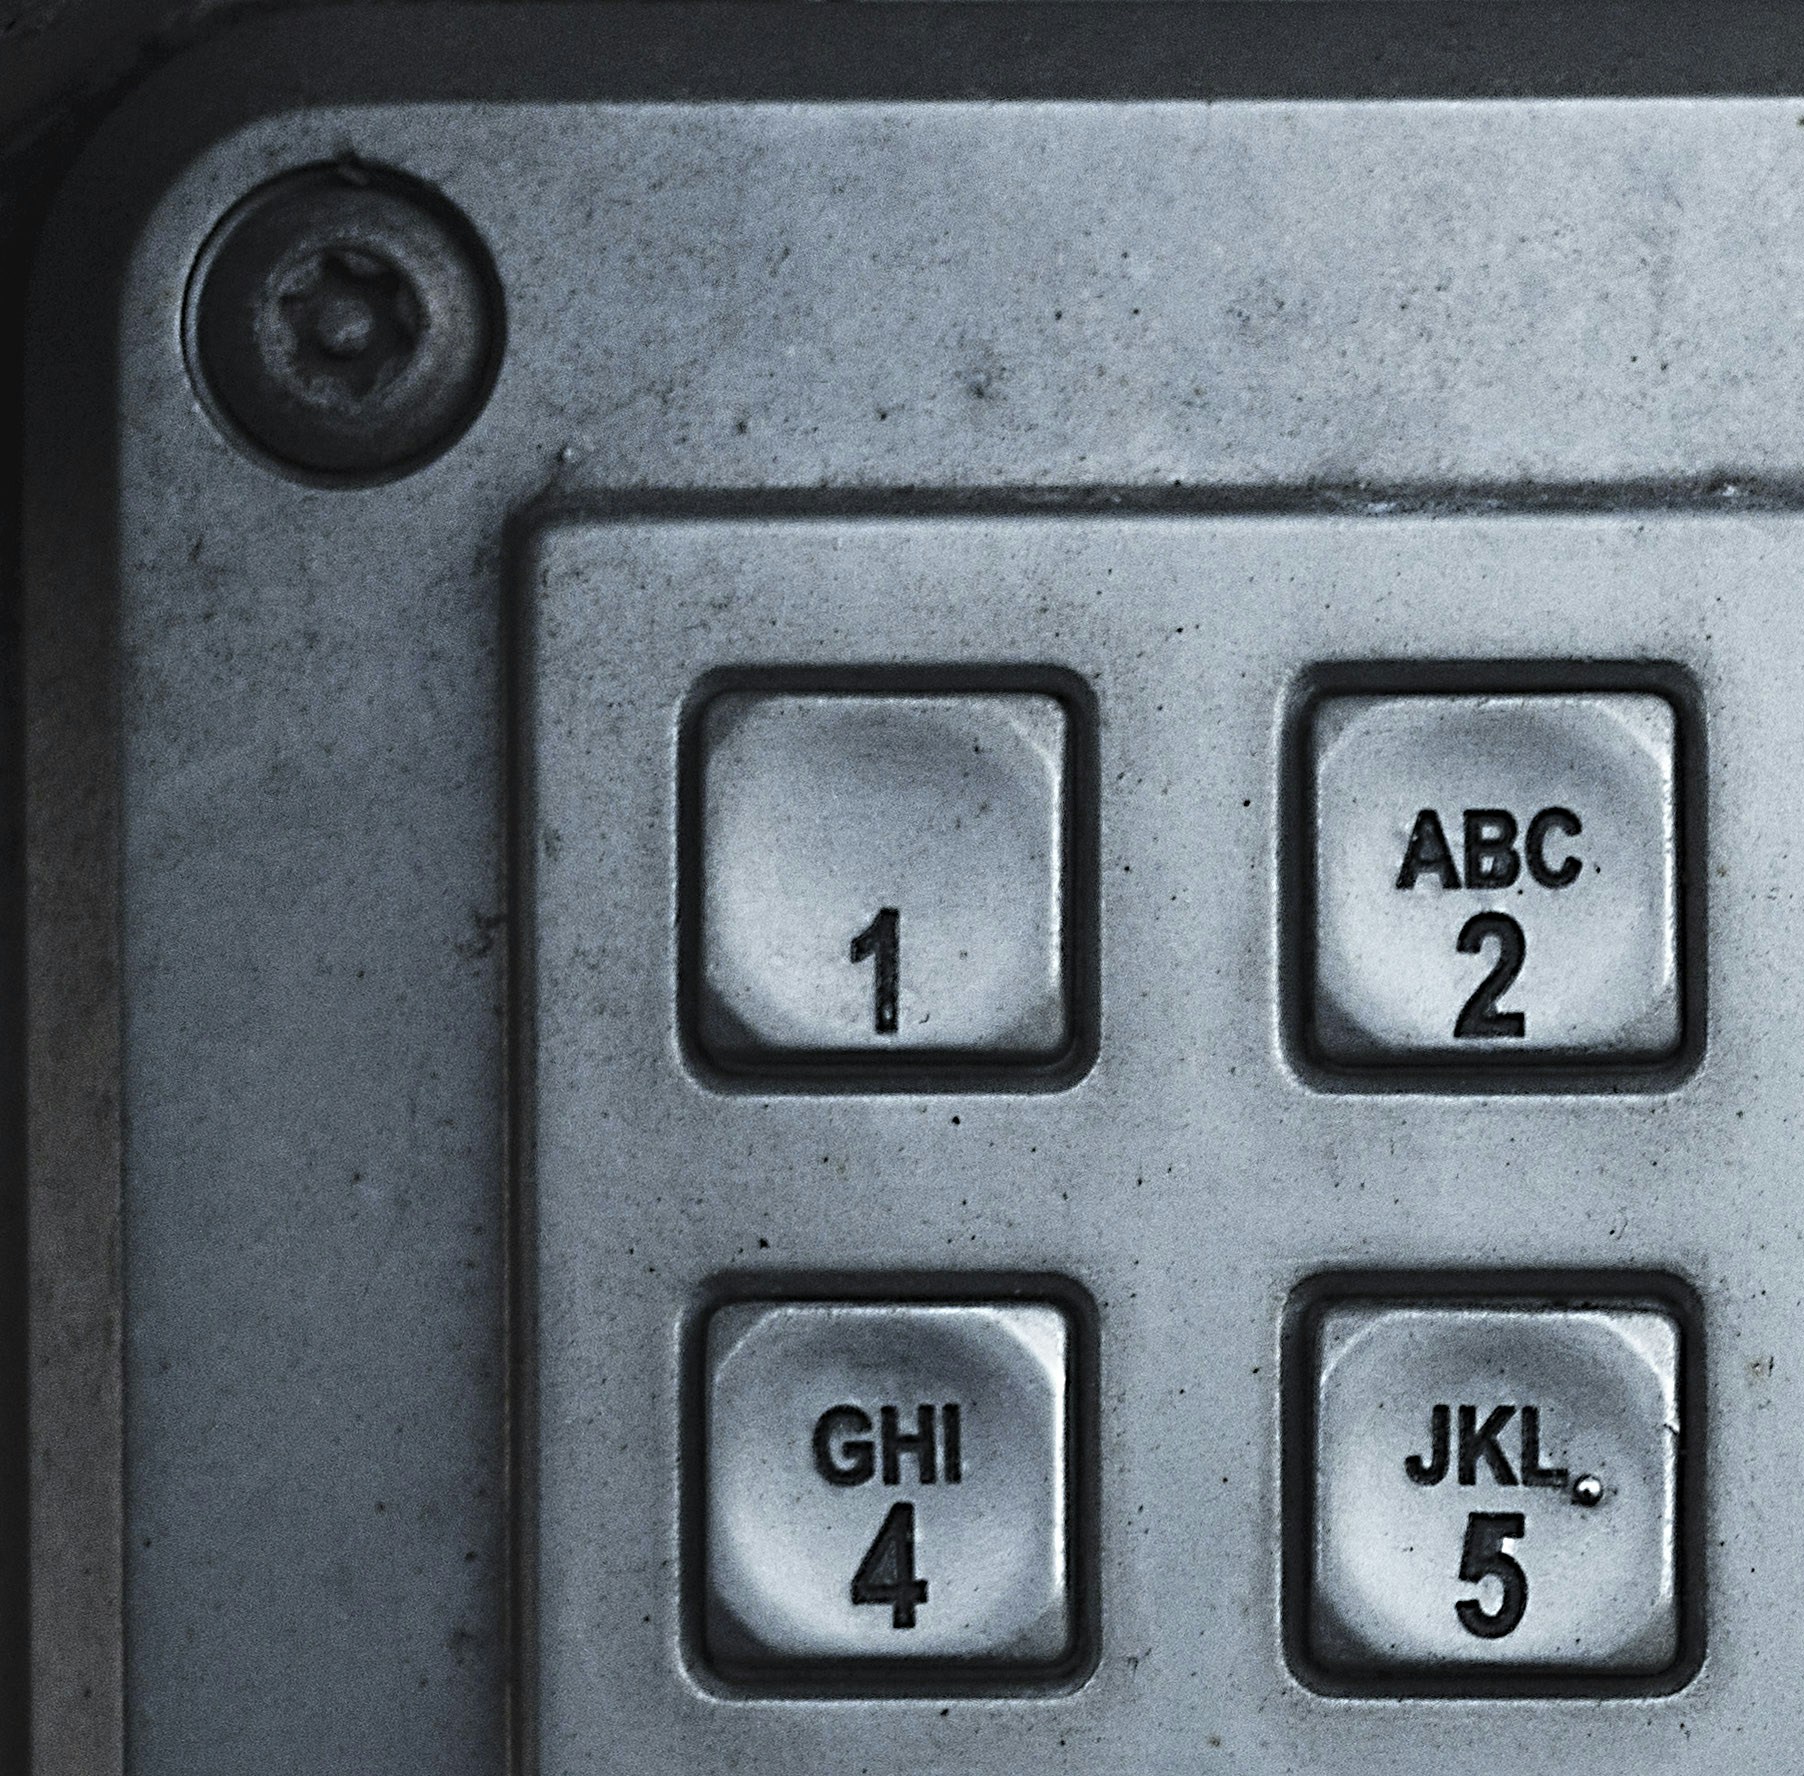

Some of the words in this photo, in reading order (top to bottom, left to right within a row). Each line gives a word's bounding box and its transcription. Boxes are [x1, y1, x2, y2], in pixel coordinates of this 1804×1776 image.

[1396, 806, 1582, 890] ABC
[850, 907, 900, 1035] 1
[1454, 911, 1525, 1039] 2
[812, 1403, 961, 1487] GHI
[1405, 1404, 1568, 1489] JKL
[850, 1501, 928, 1629] 4
[1455, 1512, 1527, 1639] 5
